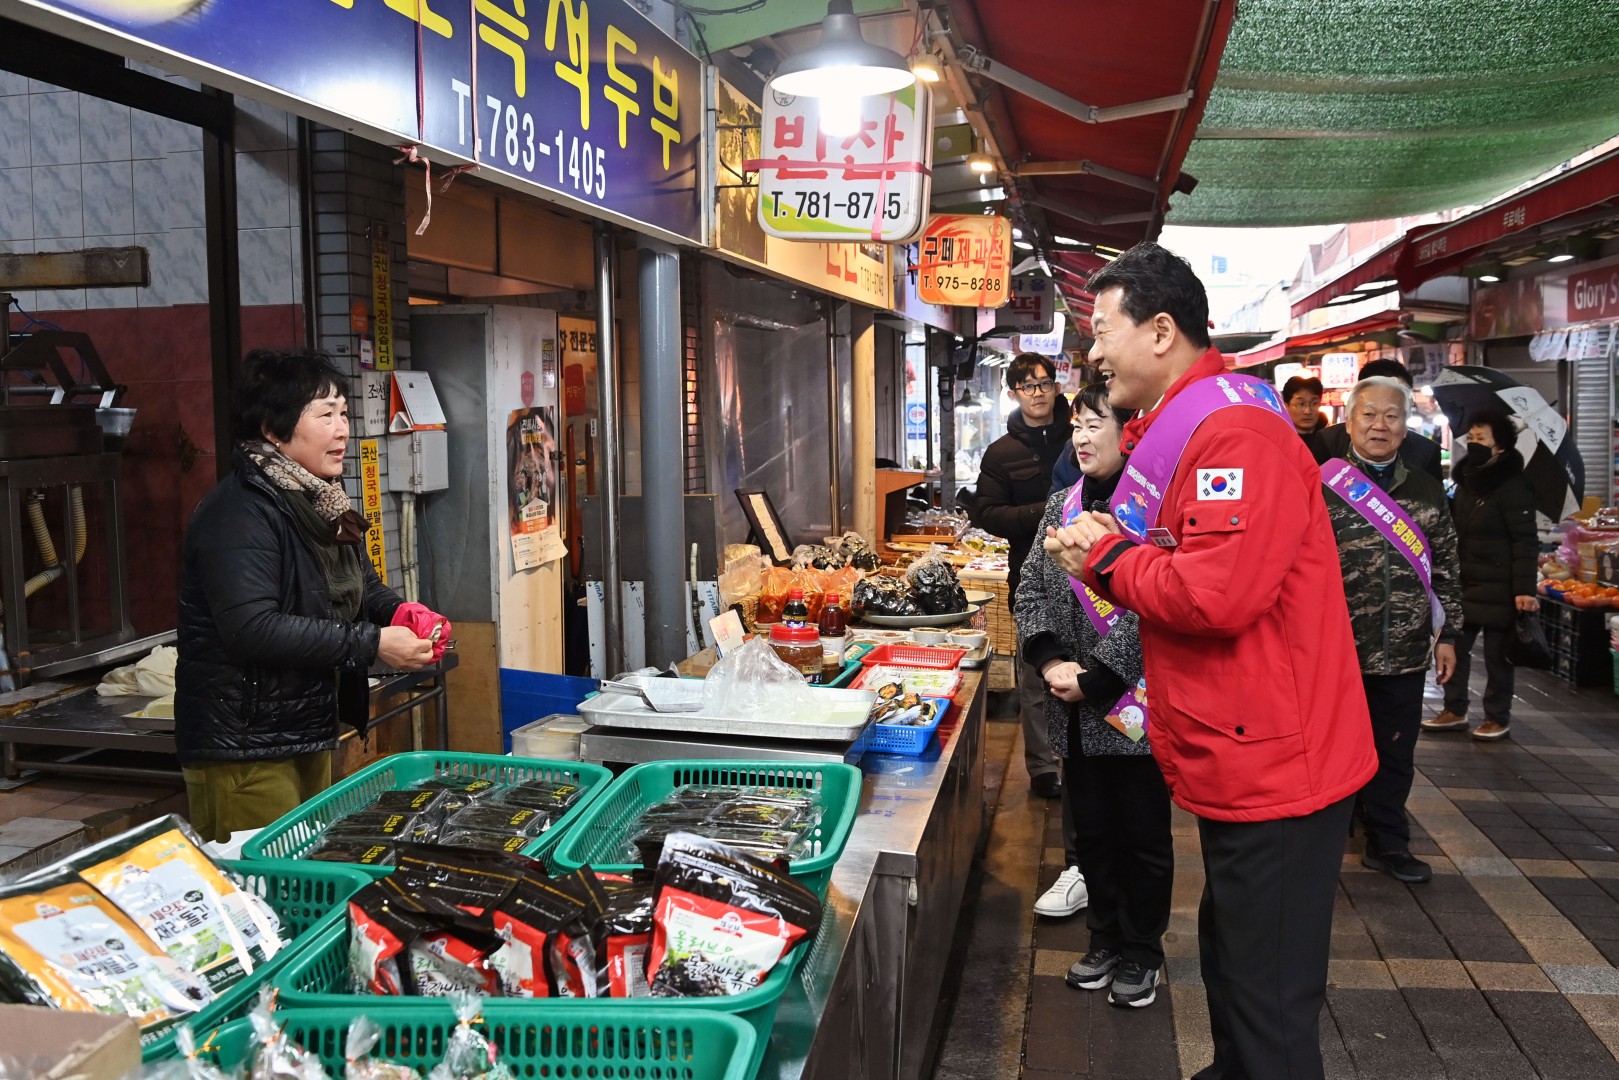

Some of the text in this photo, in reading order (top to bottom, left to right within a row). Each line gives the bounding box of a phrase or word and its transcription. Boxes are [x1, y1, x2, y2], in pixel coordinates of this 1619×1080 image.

[795, 191, 901, 219] 781-8745
[937, 276, 1001, 291] 975-8288
[1574, 272, 1619, 315] Glory S
[376, 275, 388, 325] 청국장
[1010, 296, 1041, 321] 떡
[377, 325, 391, 365] 있습니다
[368, 382, 390, 401] 조선
[361, 446, 377, 462] 국산
[365, 465, 378, 507] 청국장
[366, 511, 381, 525] 분말
